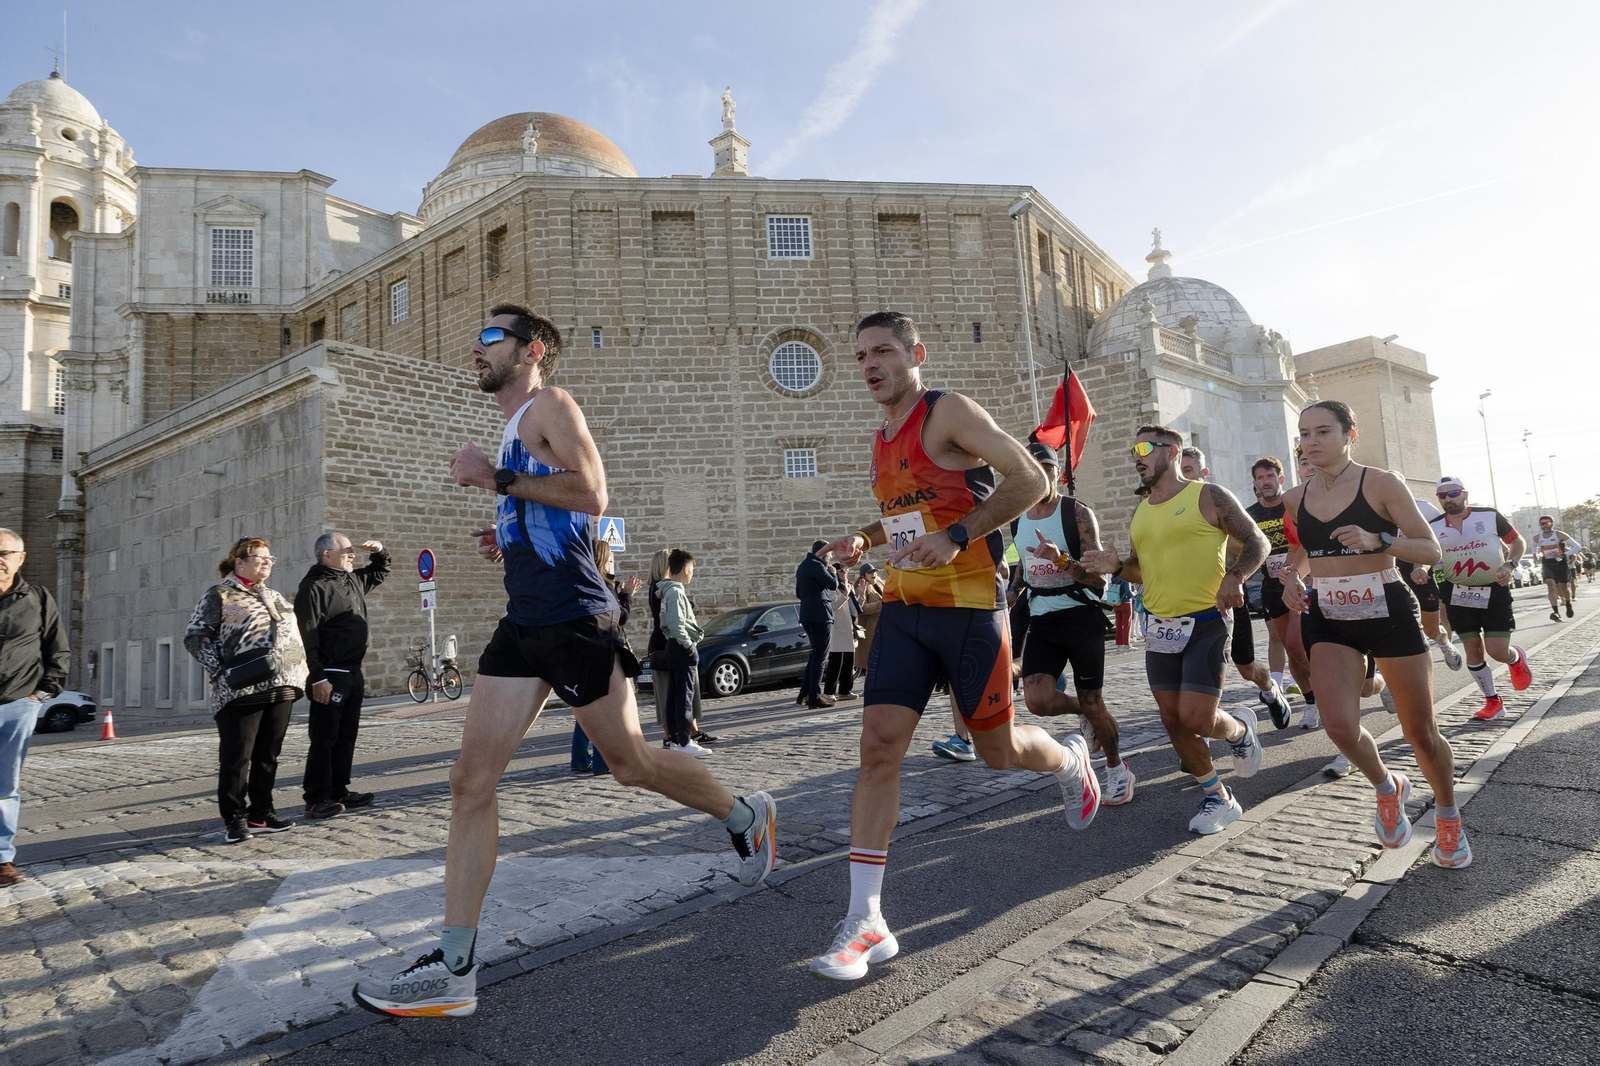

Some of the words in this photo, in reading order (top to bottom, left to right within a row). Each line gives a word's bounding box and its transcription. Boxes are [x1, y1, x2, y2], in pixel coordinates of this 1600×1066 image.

[887, 486, 938, 511] CAMAS
[892, 529, 916, 551] 787
[1445, 540, 1488, 553] maratón
[1310, 549, 1324, 557] NIKE
[1031, 563, 1064, 576] 2582
[1326, 586, 1375, 606] 1964
[1459, 591, 1481, 601] 879
[1156, 626, 1182, 641] 563
[389, 977, 450, 996] BROOKS
